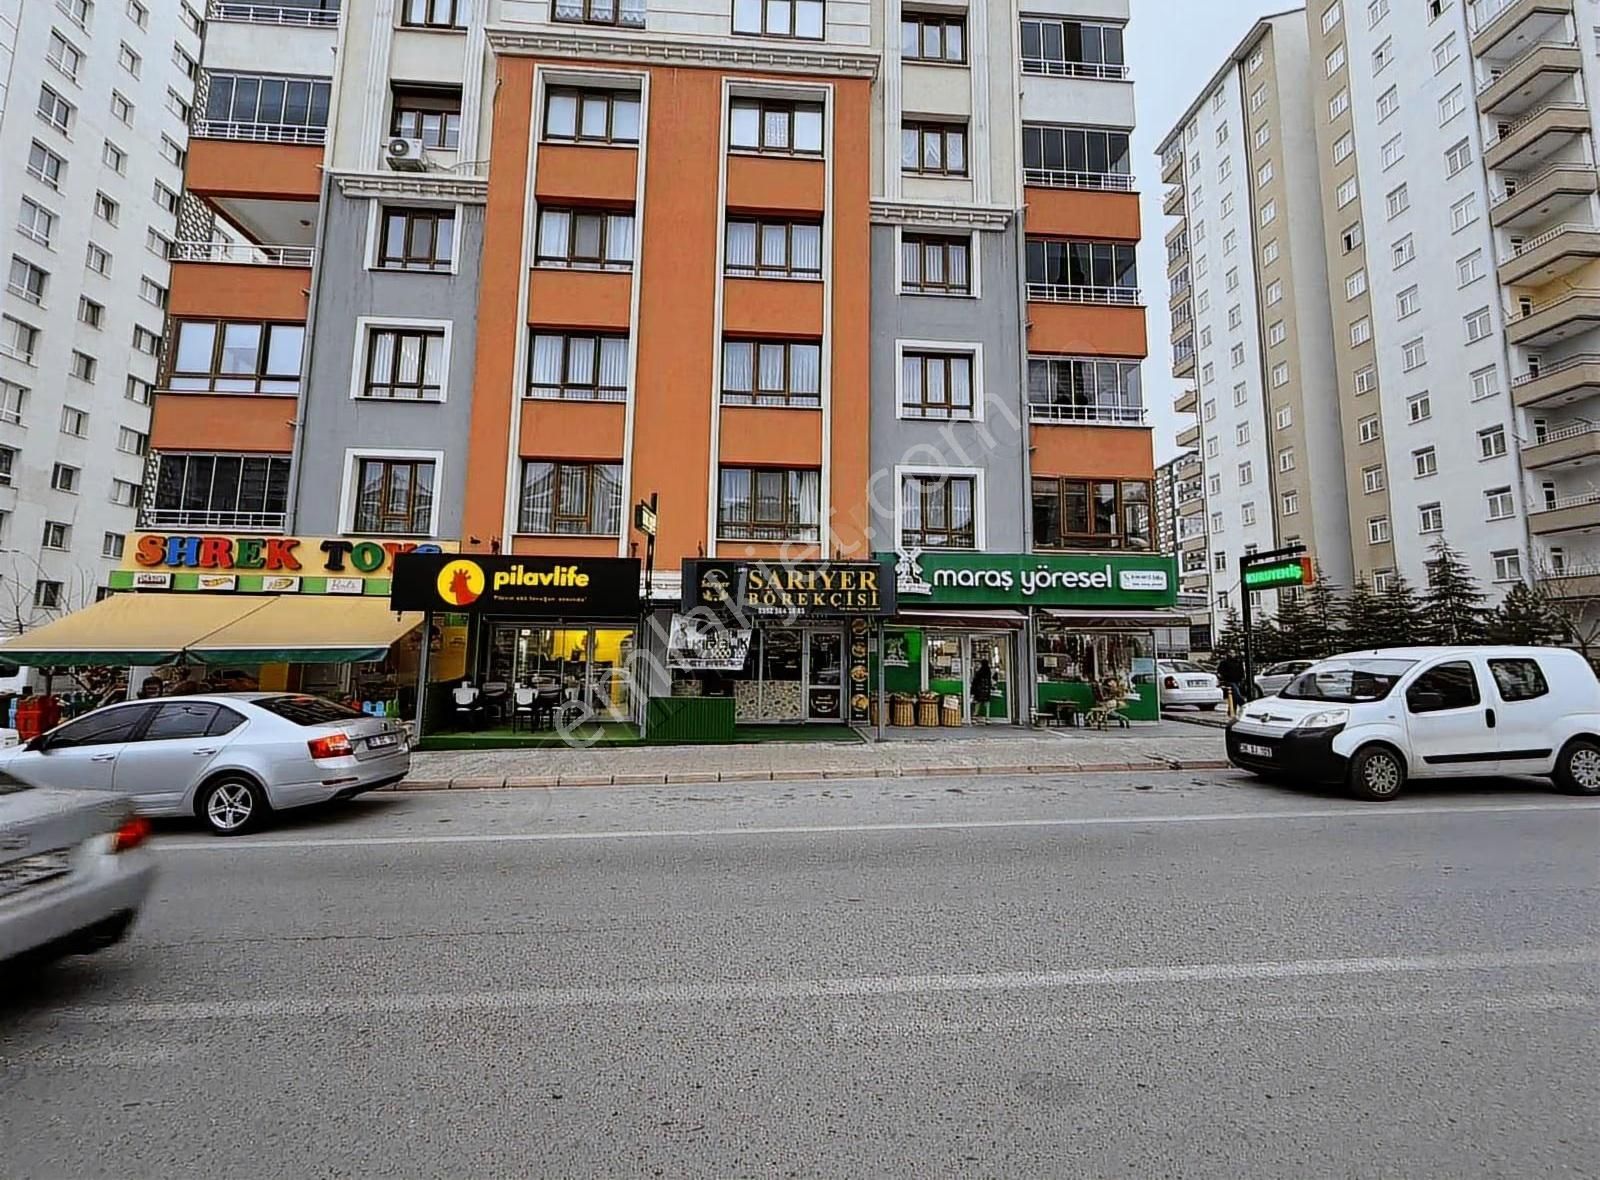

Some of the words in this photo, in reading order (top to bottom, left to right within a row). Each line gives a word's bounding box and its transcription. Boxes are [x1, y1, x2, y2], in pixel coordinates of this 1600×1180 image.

[135, 535, 302, 569] SHREK
[320, 540, 442, 572] TOY
[493, 564, 590, 591] pilavlife
[748, 569, 879, 590] SARIYER
[933, 569, 1014, 591] maraş
[1021, 564, 1113, 596] yöresel
[748, 590, 879, 607] BÖREKÇİSİ
